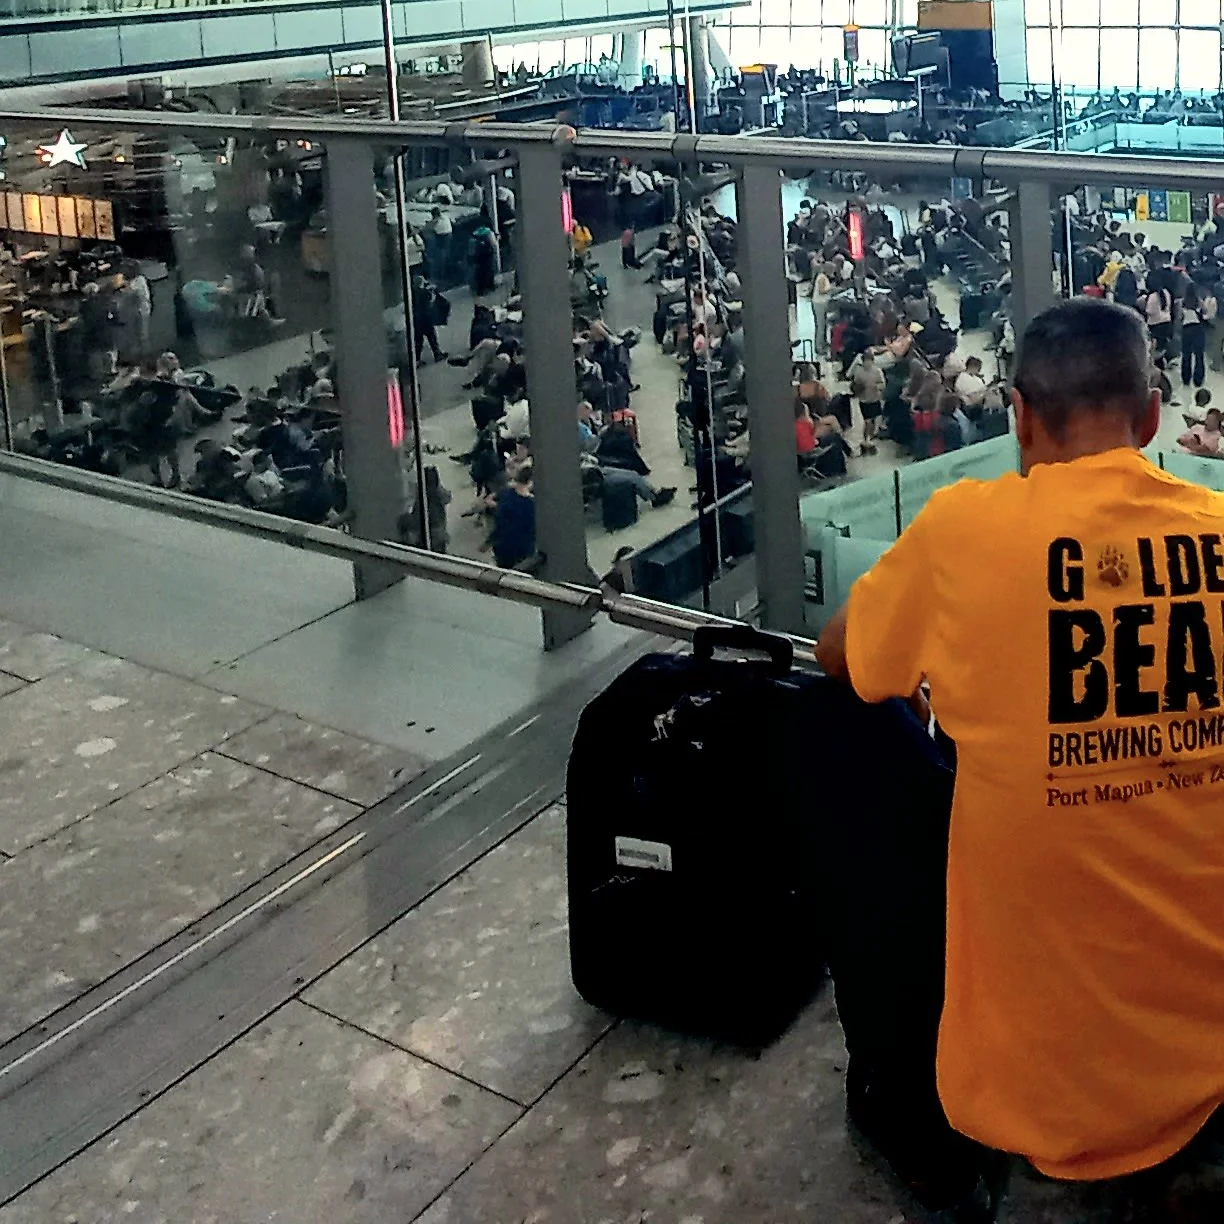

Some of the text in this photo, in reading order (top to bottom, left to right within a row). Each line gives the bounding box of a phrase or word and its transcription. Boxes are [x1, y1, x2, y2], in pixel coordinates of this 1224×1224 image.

[1048, 724, 1163, 768] BREWING
[1046, 787, 1089, 807] Port
[1094, 780, 1154, 803] Mapua
[1165, 770, 1205, 791] New
